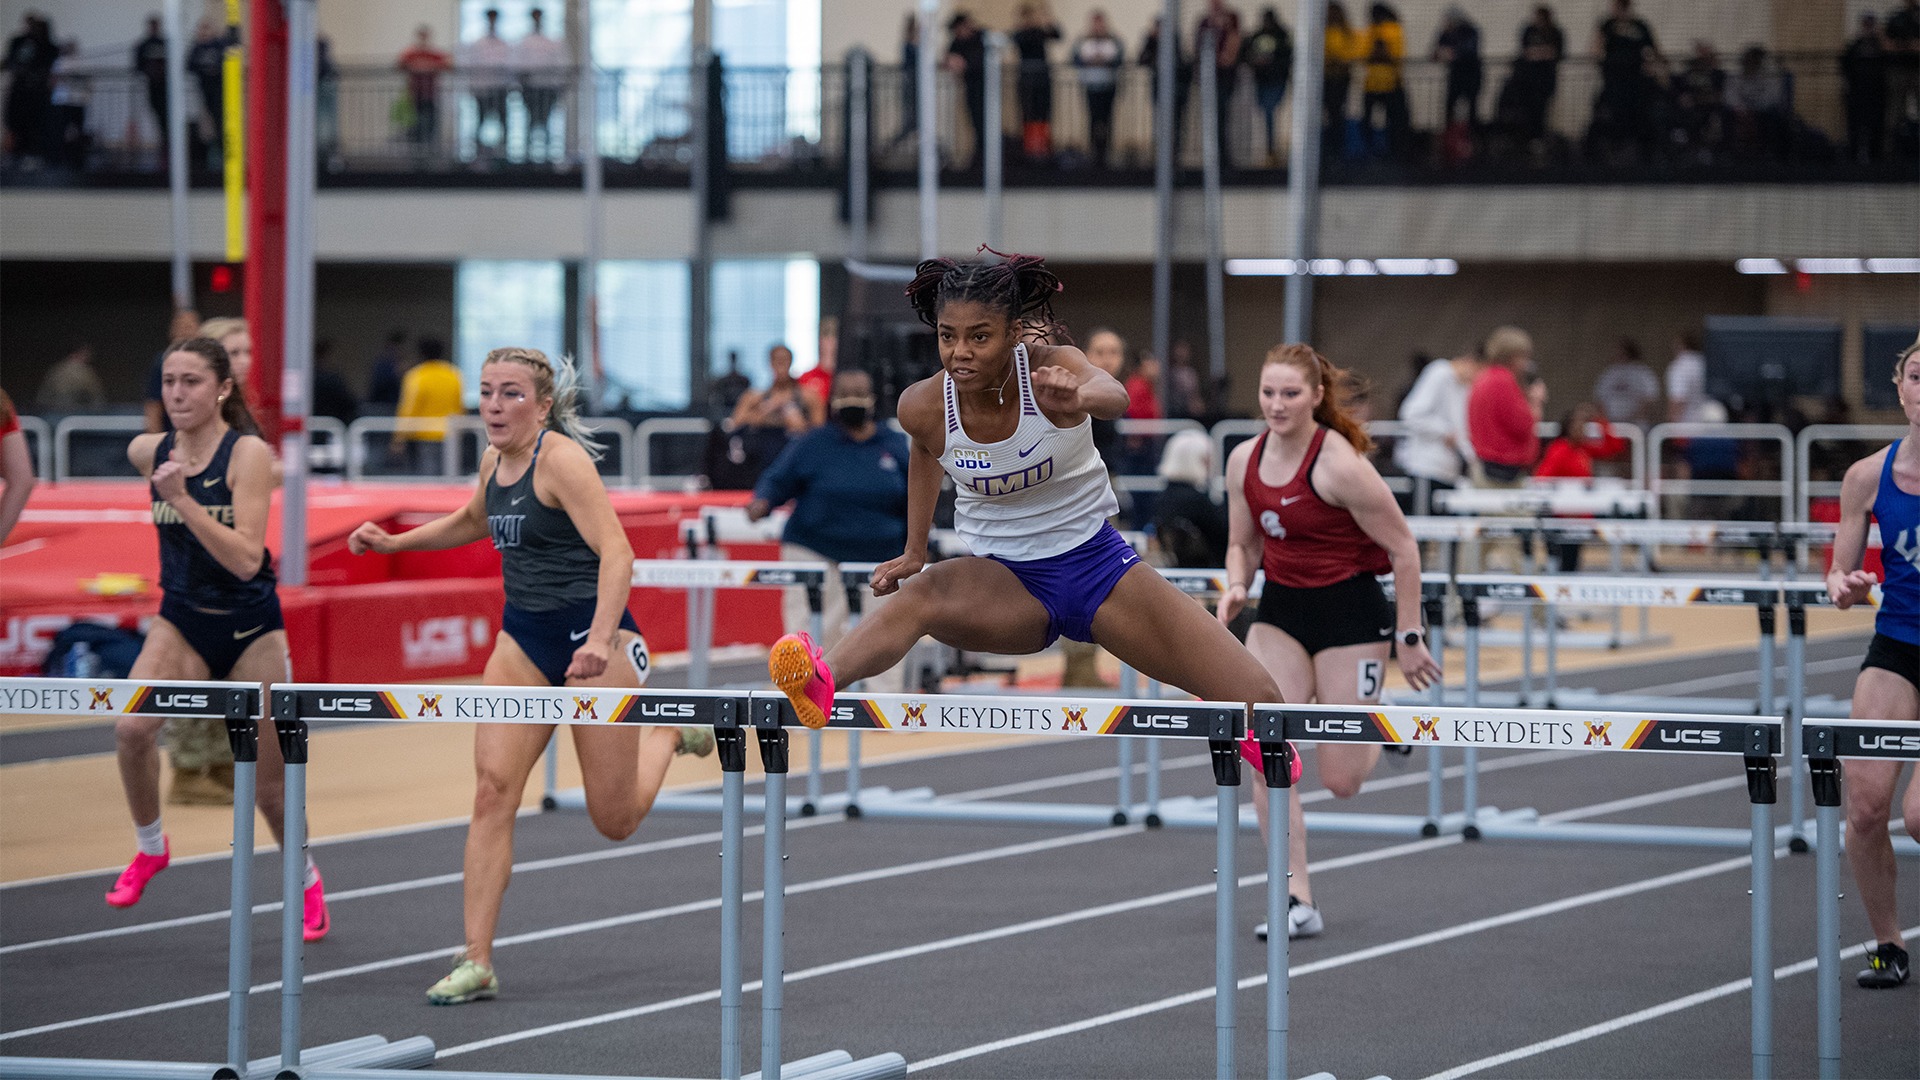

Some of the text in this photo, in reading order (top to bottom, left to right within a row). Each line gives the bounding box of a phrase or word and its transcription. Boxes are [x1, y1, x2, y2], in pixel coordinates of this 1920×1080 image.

[953, 448, 992, 470] SBC
[964, 456, 1054, 497] JMU
[151, 500, 235, 525] WINTE
[632, 642, 648, 672] 6
[1364, 662, 1378, 696] 5
[0, 688, 80, 710] YDETS
[155, 694, 209, 708] UCS
[318, 697, 373, 712] UCS
[455, 697, 564, 719] KEYDETS
[641, 702, 697, 717] UCS
[939, 706, 1052, 731] KEYDETS
[1132, 714, 1190, 729] UCS
[1304, 719, 1363, 734] UCS
[1453, 719, 1574, 746] KEYDETS
[1660, 729, 1722, 745] UCS
[1859, 734, 1920, 751] UCS
